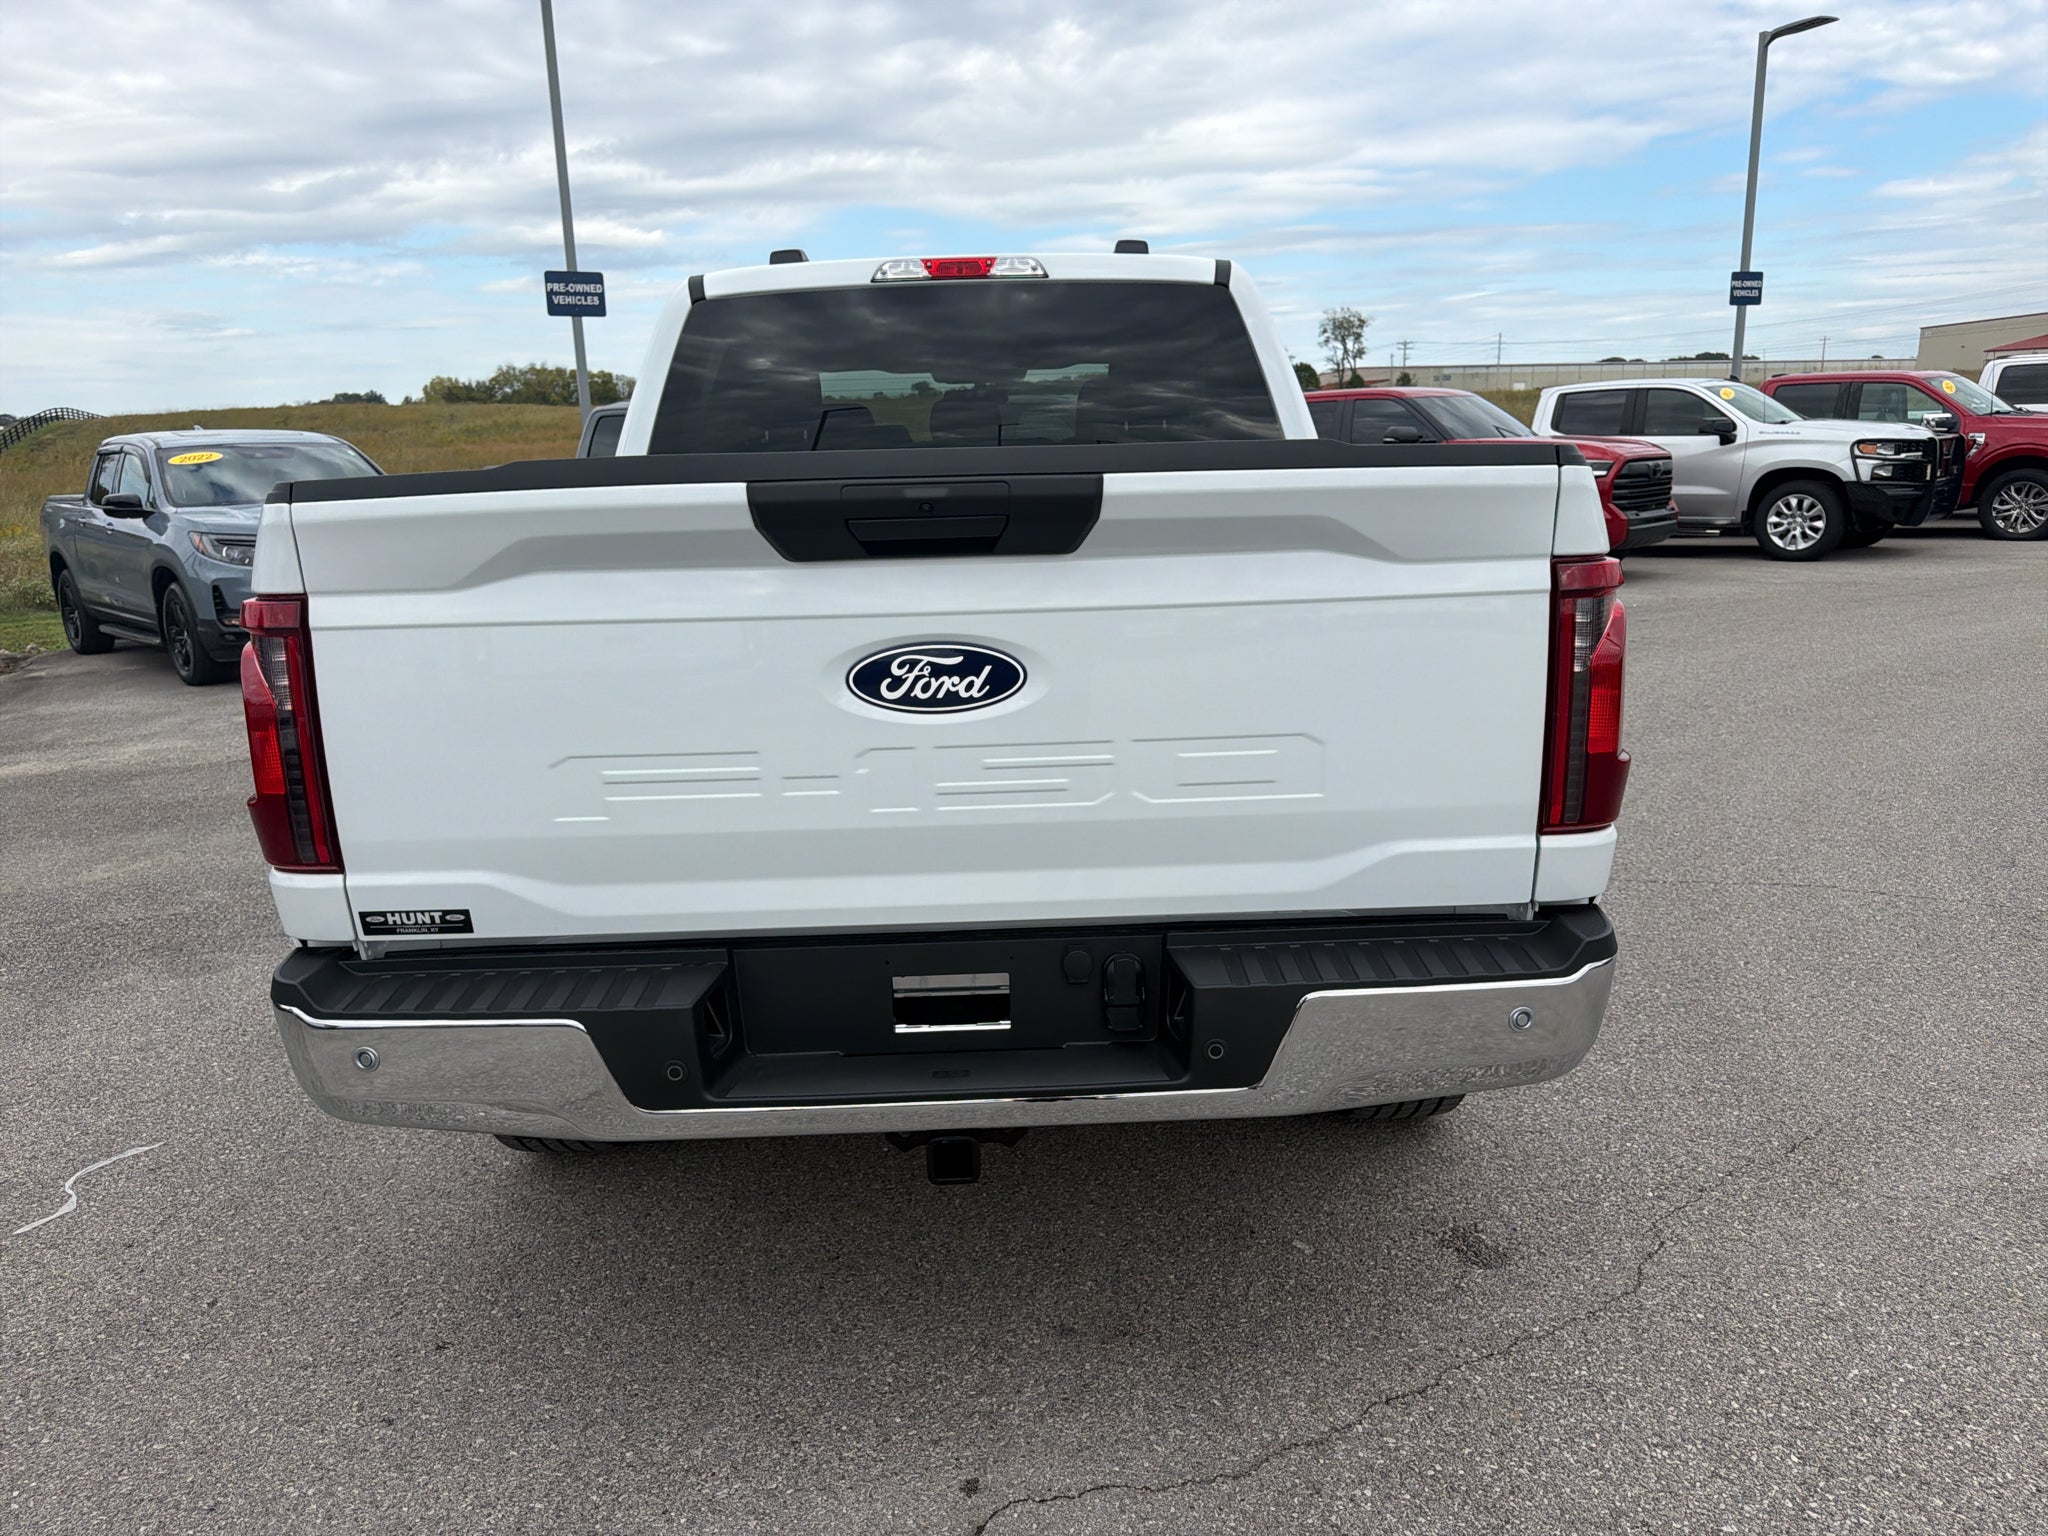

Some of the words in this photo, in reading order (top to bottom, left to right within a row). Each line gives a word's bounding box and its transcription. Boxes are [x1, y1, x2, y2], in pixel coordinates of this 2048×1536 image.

[546, 282, 603, 294] PRE-OWNED
[1731, 280, 1762, 288] PRE-OWNED
[1733, 289, 1759, 297] VEHICLES
[551, 294, 600, 306] VEHICLES
[179, 453, 213, 463] 2022
[880, 655, 992, 700] Ford
[548, 733, 1325, 822] F-150
[386, 911, 443, 925] HUNT
